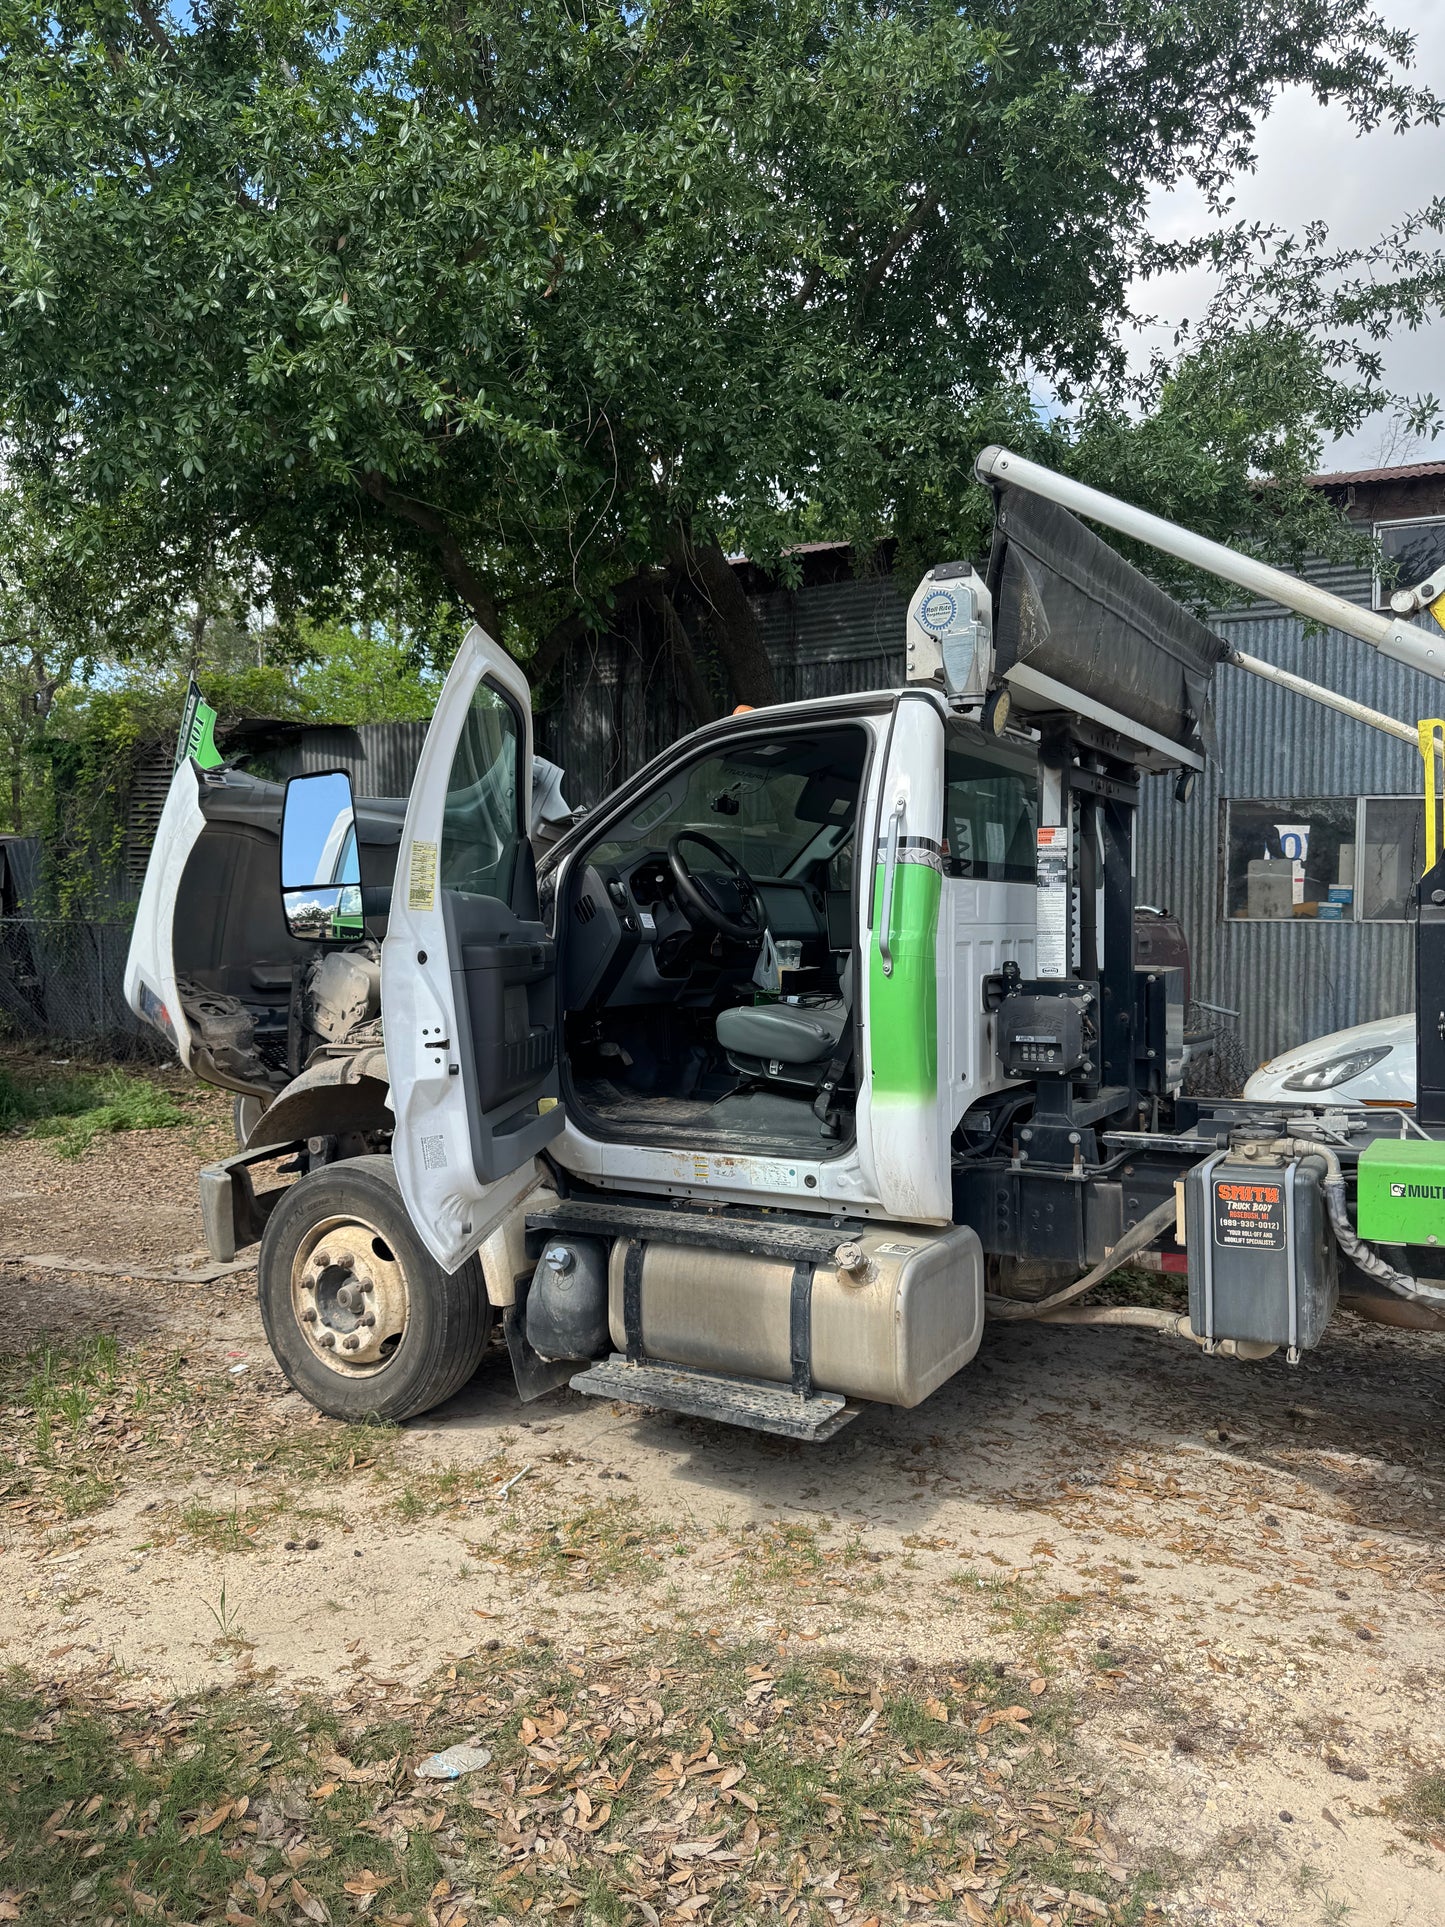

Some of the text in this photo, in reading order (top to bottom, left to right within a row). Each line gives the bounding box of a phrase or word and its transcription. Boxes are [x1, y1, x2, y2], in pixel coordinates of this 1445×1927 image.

[1218, 1185, 1279, 1203] SMITH
[1225, 1201, 1273, 1212] TRUCK BODY
